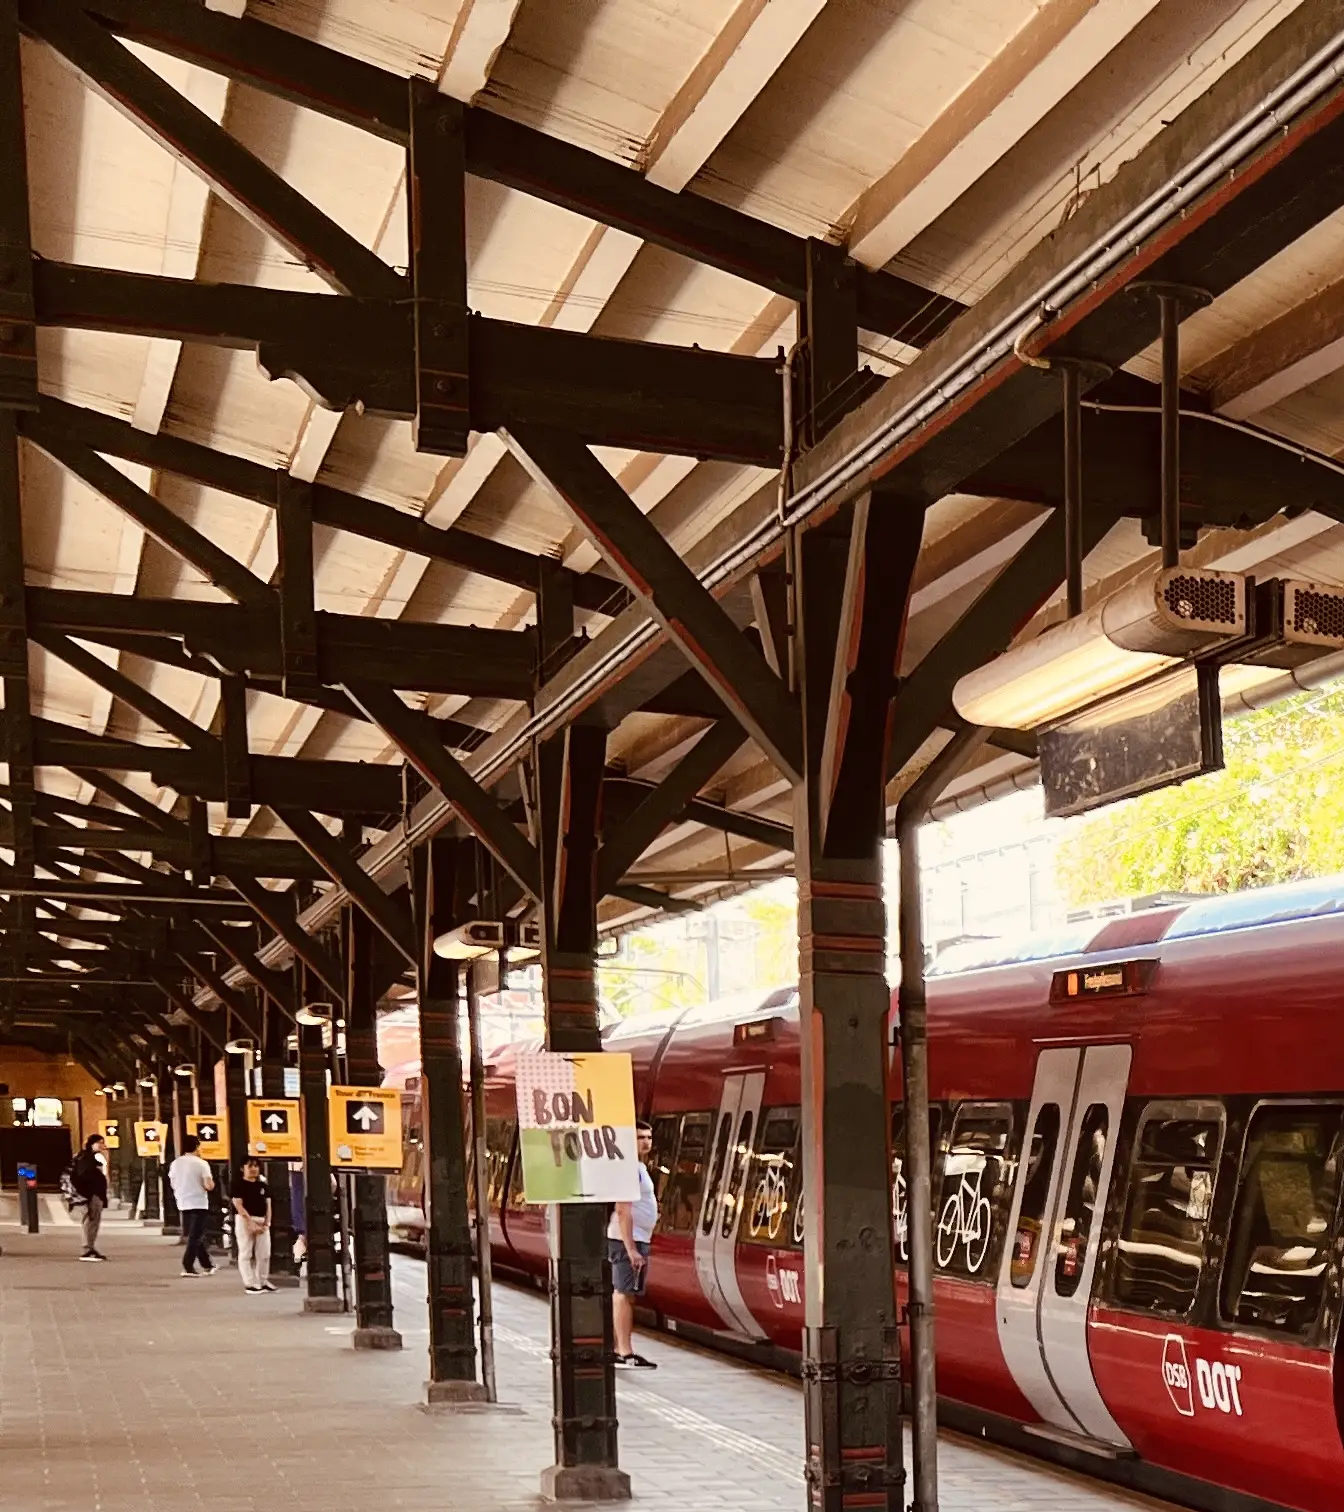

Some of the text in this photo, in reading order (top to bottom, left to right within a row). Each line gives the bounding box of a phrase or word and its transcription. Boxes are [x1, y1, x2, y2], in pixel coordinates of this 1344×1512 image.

[532, 1088, 594, 1125] BON
[547, 1125, 624, 1167] TOUR
[1165, 1357, 1242, 1416] DSB DOT
